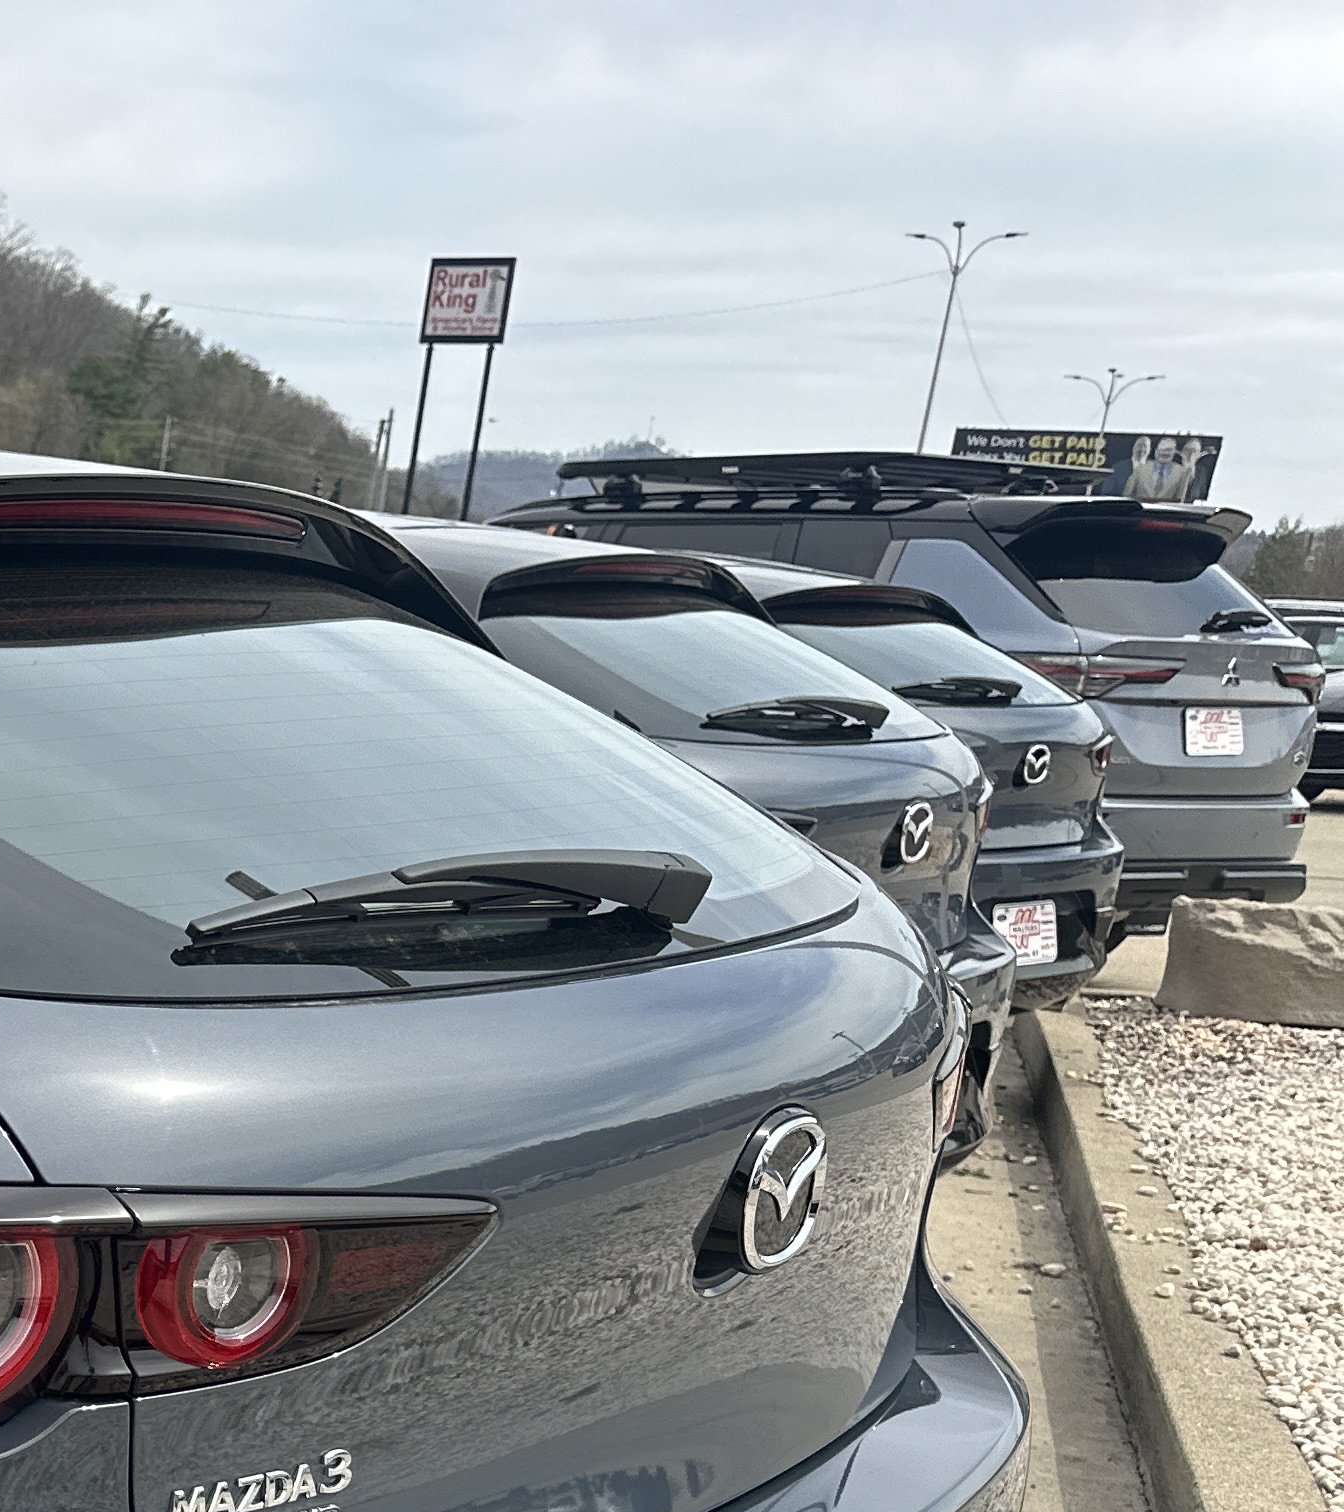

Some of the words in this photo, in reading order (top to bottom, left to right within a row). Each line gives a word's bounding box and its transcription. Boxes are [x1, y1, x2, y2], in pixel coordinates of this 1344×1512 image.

[434, 269, 488, 288] Rural
[432, 290, 477, 313] King
[967, 435, 988, 447] We
[1028, 435, 1064, 449] GET
[1066, 435, 1107, 450] PAID
[1027, 451, 1064, 464] GET
[1066, 451, 1106, 467] PAID
